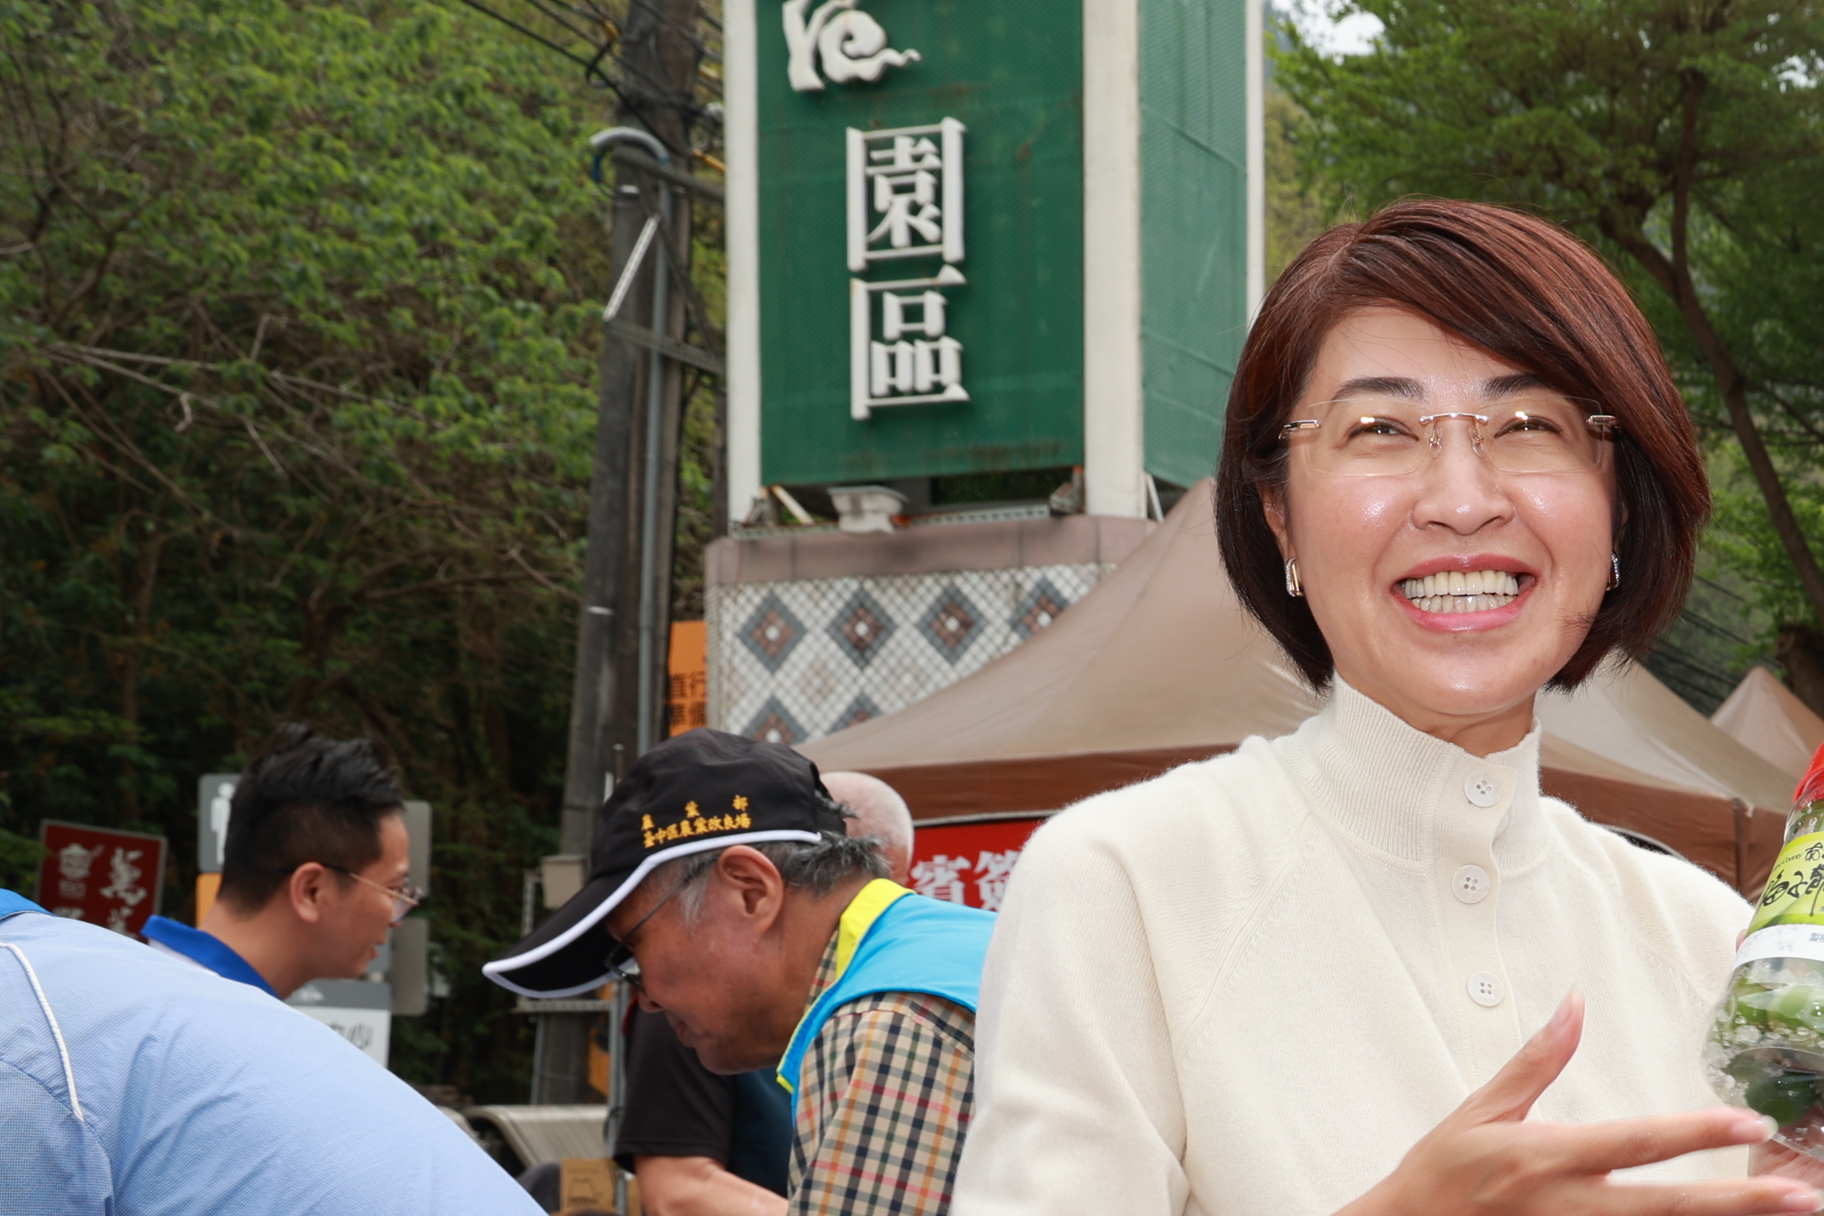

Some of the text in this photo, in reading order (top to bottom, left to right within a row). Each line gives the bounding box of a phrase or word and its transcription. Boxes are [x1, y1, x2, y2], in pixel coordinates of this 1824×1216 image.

[845, 116, 971, 422] 園區
[642, 812, 753, 849] 臺中區農業改良場
